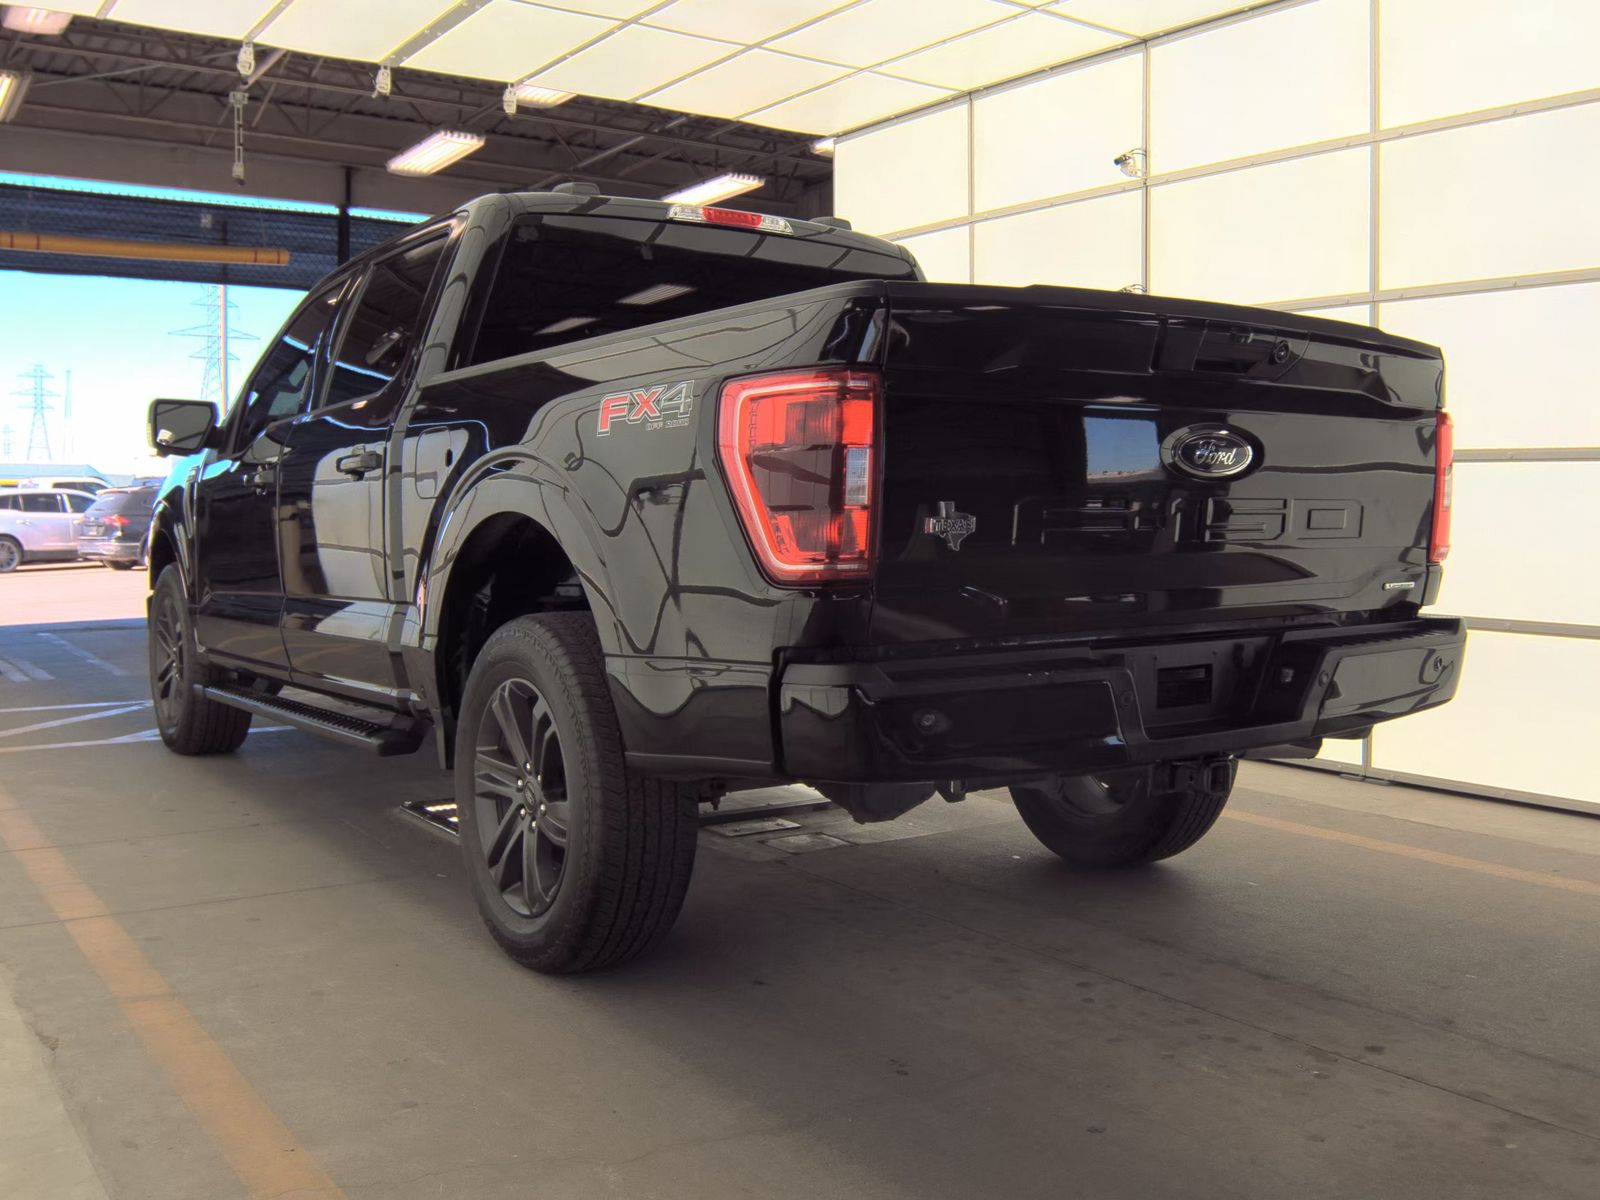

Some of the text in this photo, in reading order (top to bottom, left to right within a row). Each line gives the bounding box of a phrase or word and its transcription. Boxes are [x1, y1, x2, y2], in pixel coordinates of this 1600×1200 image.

[597, 380, 694, 436] FX4
[645, 421, 664, 431] OFF
[1189, 439, 1237, 465] Ford
